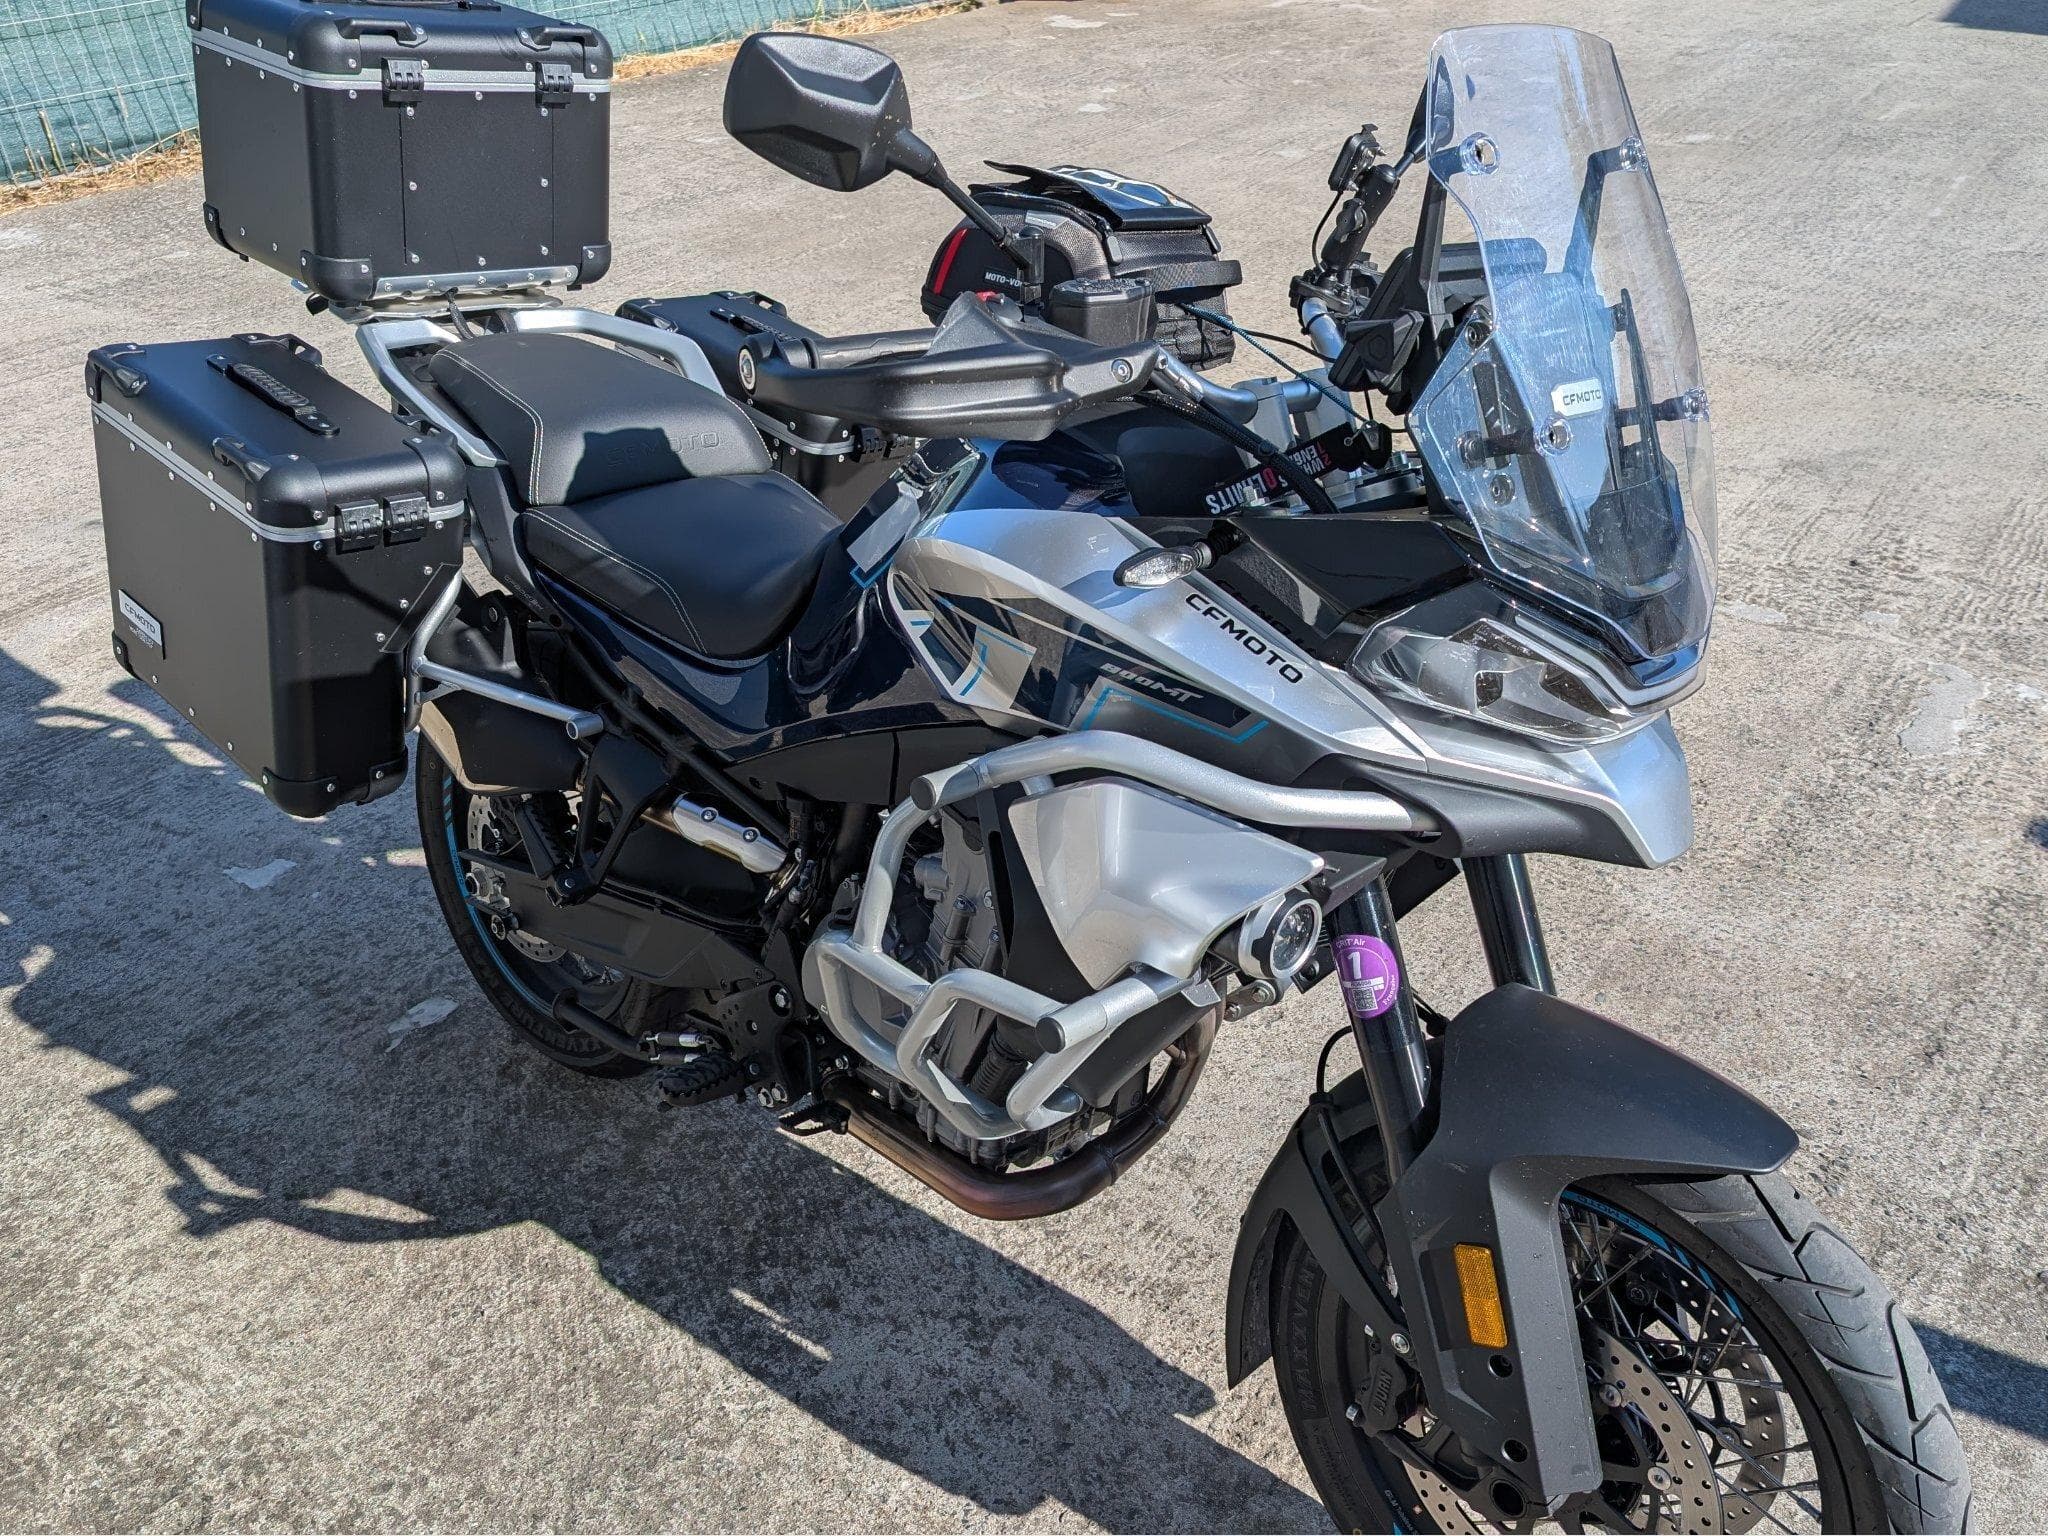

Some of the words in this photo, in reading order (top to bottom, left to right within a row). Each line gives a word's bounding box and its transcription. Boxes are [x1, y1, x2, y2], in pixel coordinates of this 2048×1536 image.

[985, 271, 1023, 288] MOTO-VO
[1562, 389, 1602, 406] CFMOTO
[124, 603, 156, 634] CFMOTO
[1185, 594, 1303, 684] CFMOTO
[1347, 951, 1362, 980] 1
